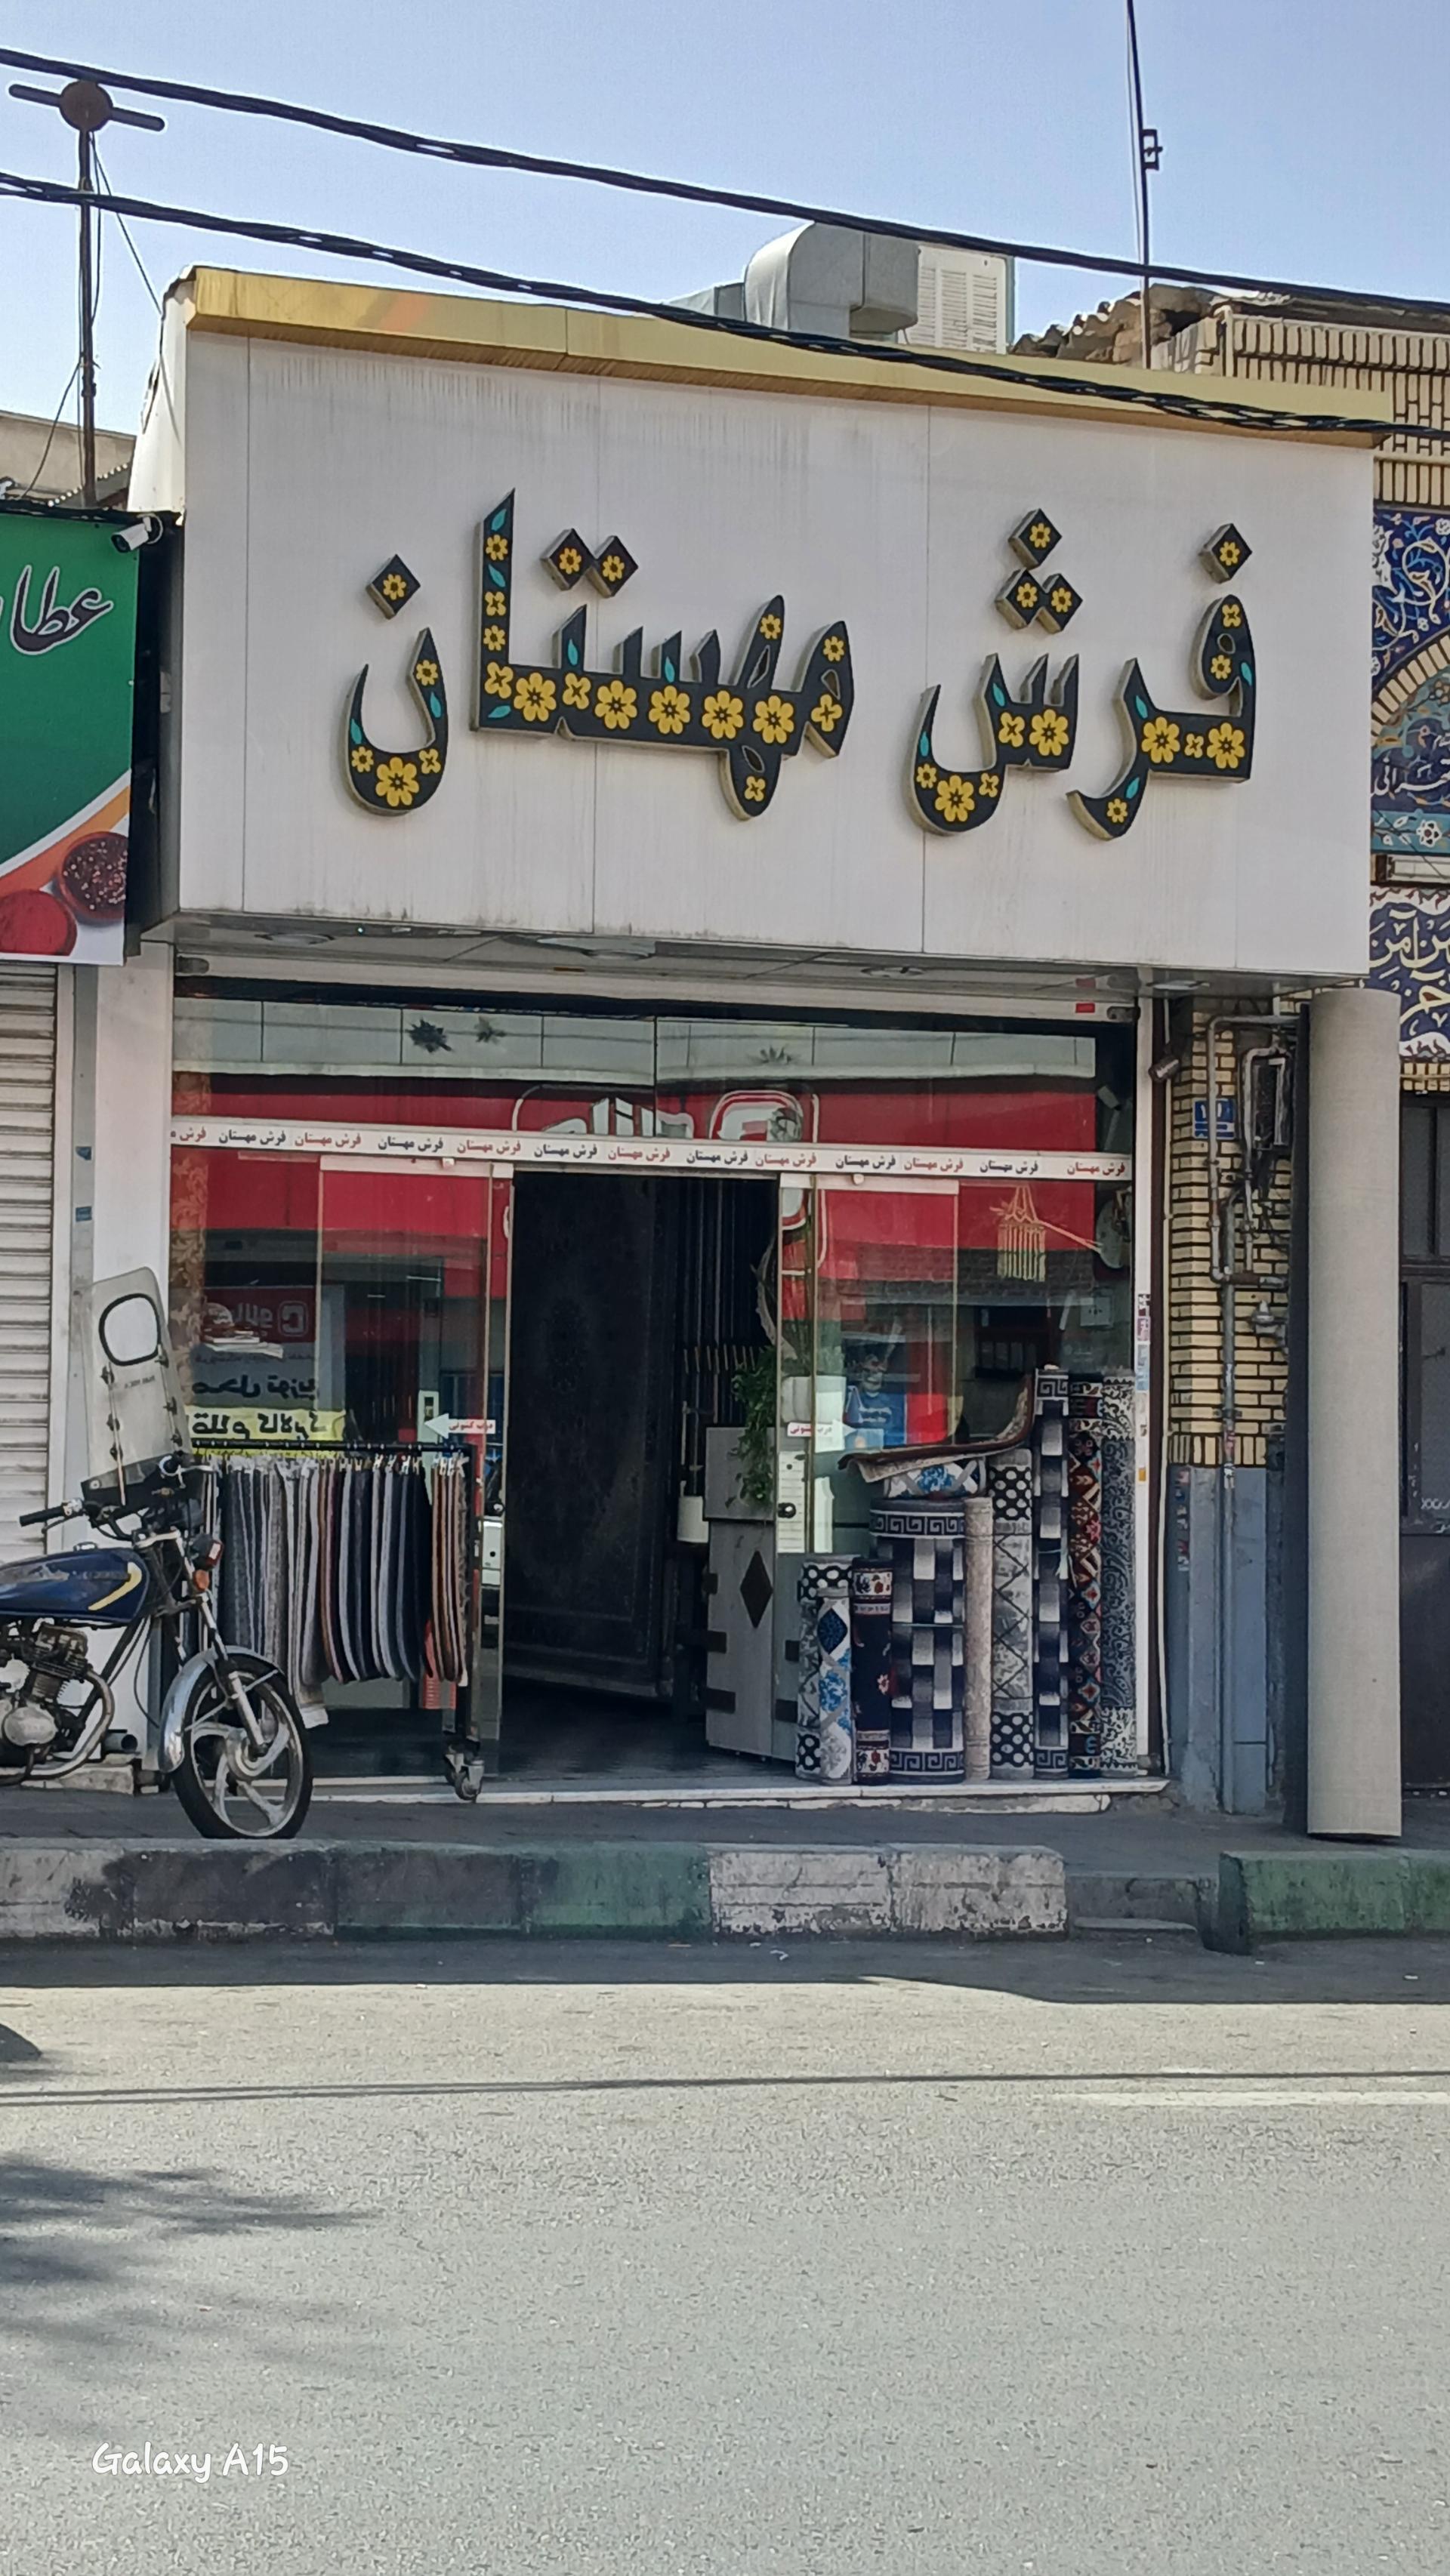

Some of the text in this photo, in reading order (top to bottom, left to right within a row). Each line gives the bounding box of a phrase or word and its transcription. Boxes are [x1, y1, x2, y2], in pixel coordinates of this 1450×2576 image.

[0, 564, 113, 655] عطا
[344, 487, 1257, 841] فرش مهستان
[180, 1127, 205, 1142] فرش
[219, 1129, 256, 1144] مهستان
[260, 1131, 285, 1146] فرش
[295, 1132, 332, 1146] مهستان
[335, 1134, 361, 1148] فرش
[378, 1136, 415, 1150] مهستان
[418, 1138, 443, 1152] فرش
[457, 1140, 492, 1154] مهستان
[496, 1142, 520, 1155] فرش
[534, 1144, 569, 1157] مهستان
[573, 1145, 597, 1159] فرش
[609, 1147, 643, 1160] مهستان
[646, 1148, 670, 1162] فرش
[686, 1150, 720, 1163] مهستان
[724, 1151, 748, 1165] فرش
[756, 1154, 789, 1166] مهستان
[793, 1153, 816, 1167] فرش
[836, 1155, 869, 1169] مهستان
[872, 1156, 896, 1169] فرش
[904, 1157, 937, 1170] مهستان
[940, 1159, 963, 1172] فرش
[980, 1160, 1012, 1172] مهستان
[1016, 1161, 1038, 1175] فرش
[1067, 1162, 1100, 1175] مهستان
[1103, 1162, 1125, 1176] فرش
